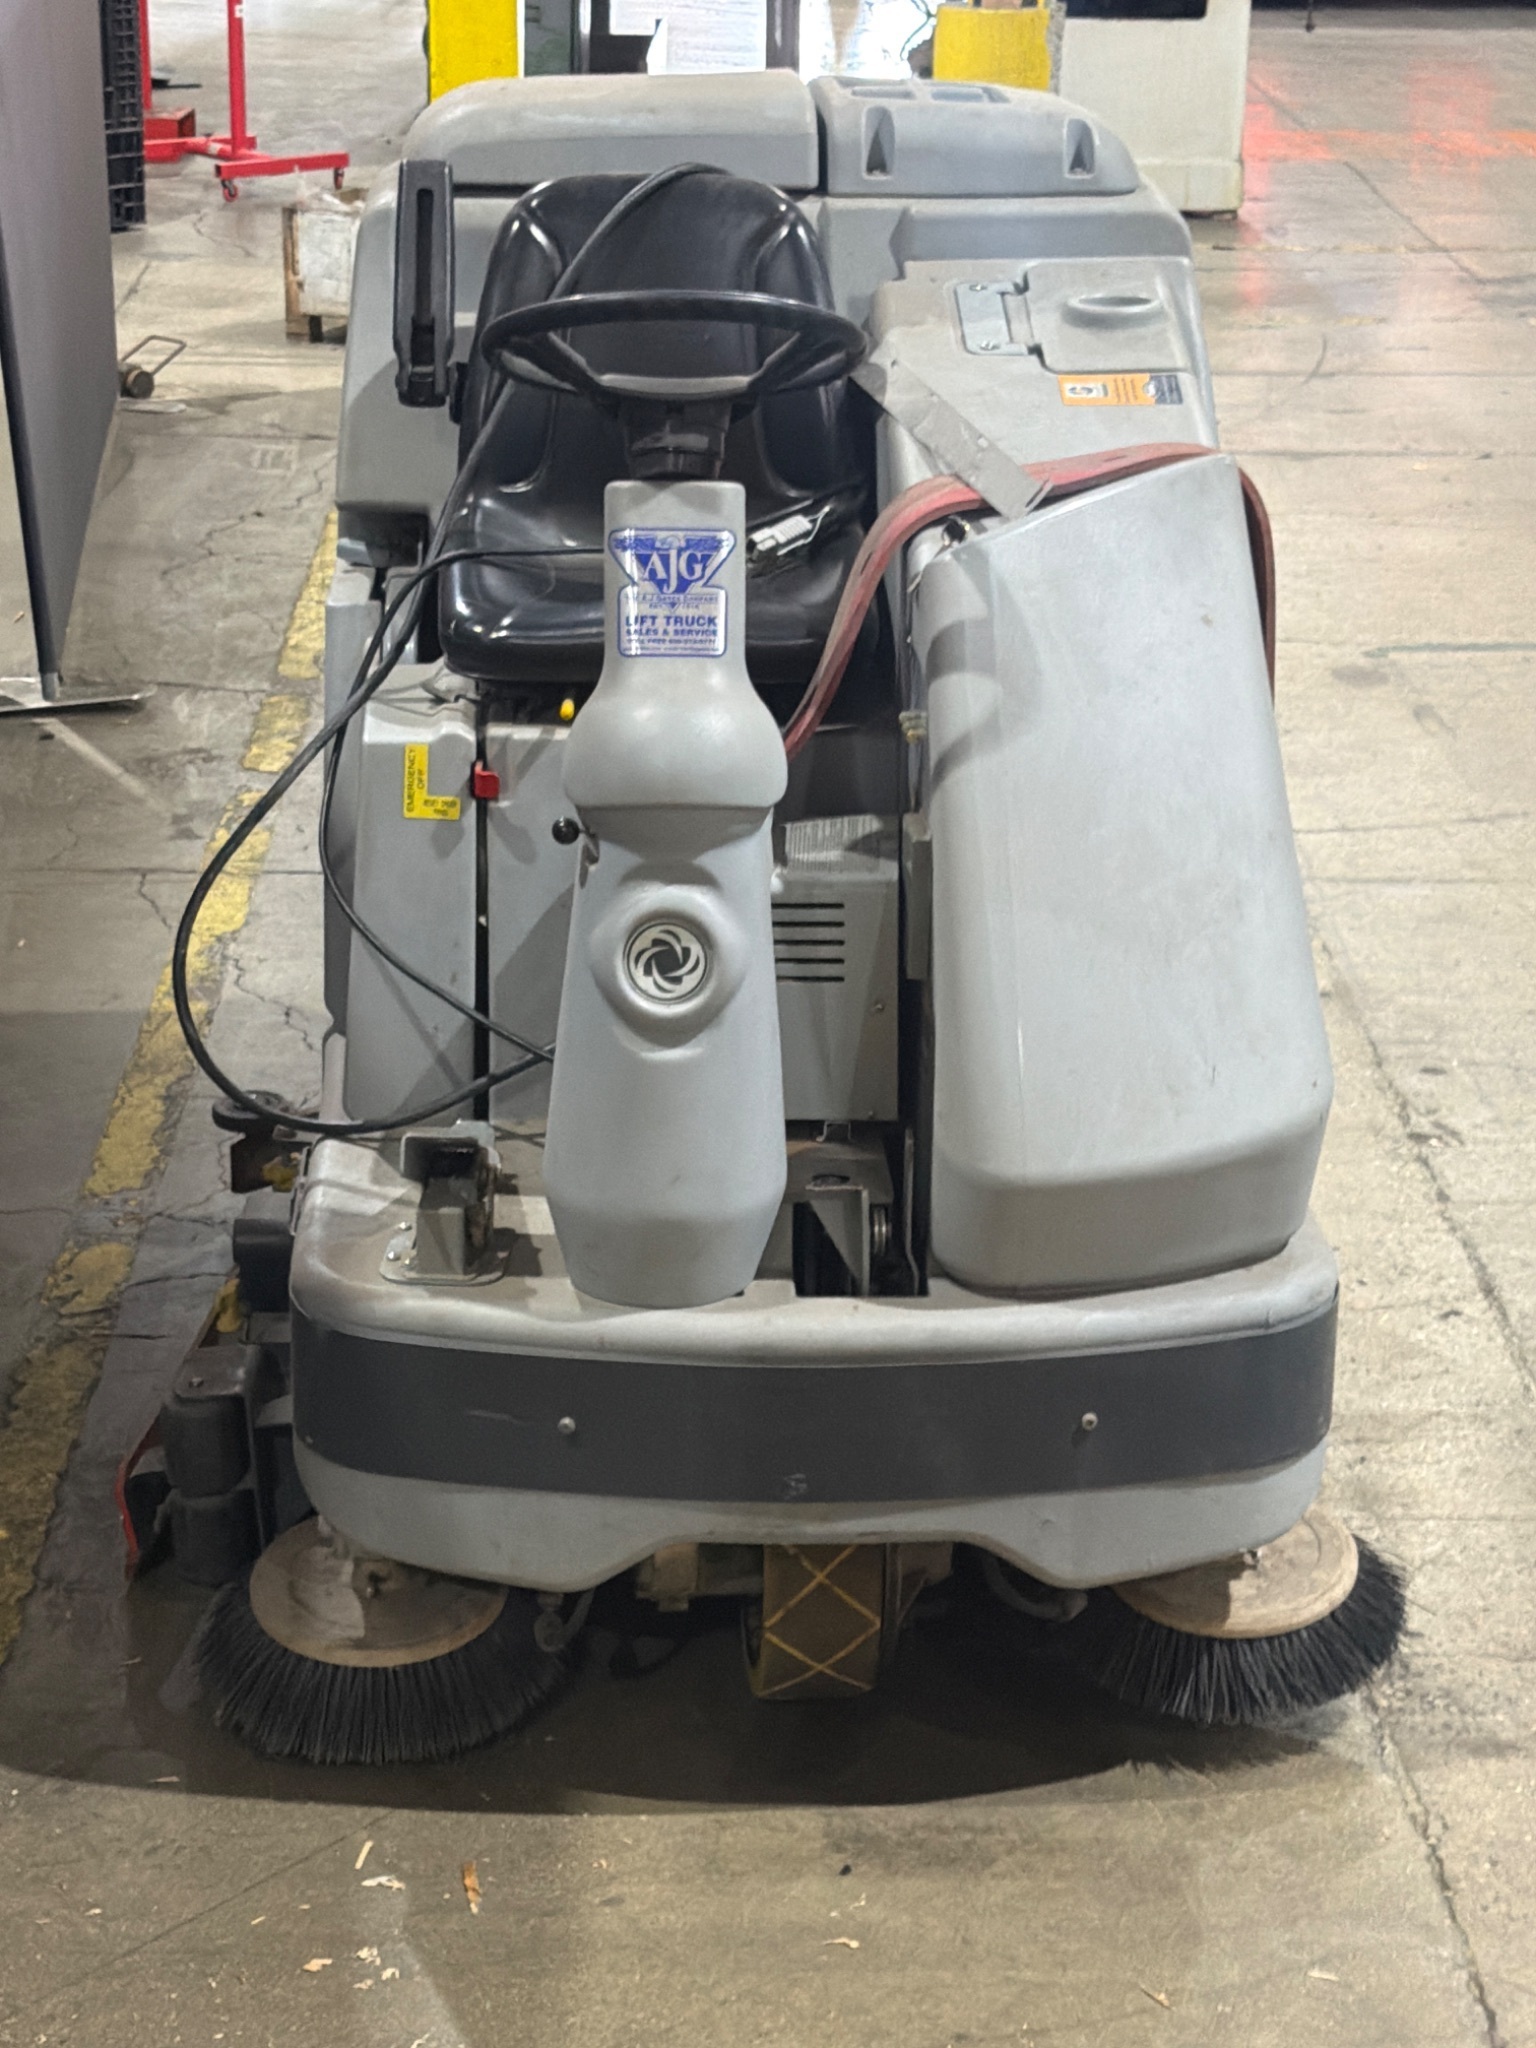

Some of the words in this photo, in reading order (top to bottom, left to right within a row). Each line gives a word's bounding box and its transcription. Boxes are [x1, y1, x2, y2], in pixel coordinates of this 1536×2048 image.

[643, 547, 704, 595] AJG
[625, 615, 658, 627] LIFT
[663, 615, 718, 627] TRUCK
[625, 628, 659, 637] SALES
[661, 628, 669, 637] &
[673, 628, 718, 637] SERVICE
[406, 749, 416, 812] EMERGENCY
[417, 768, 425, 789] OFF
